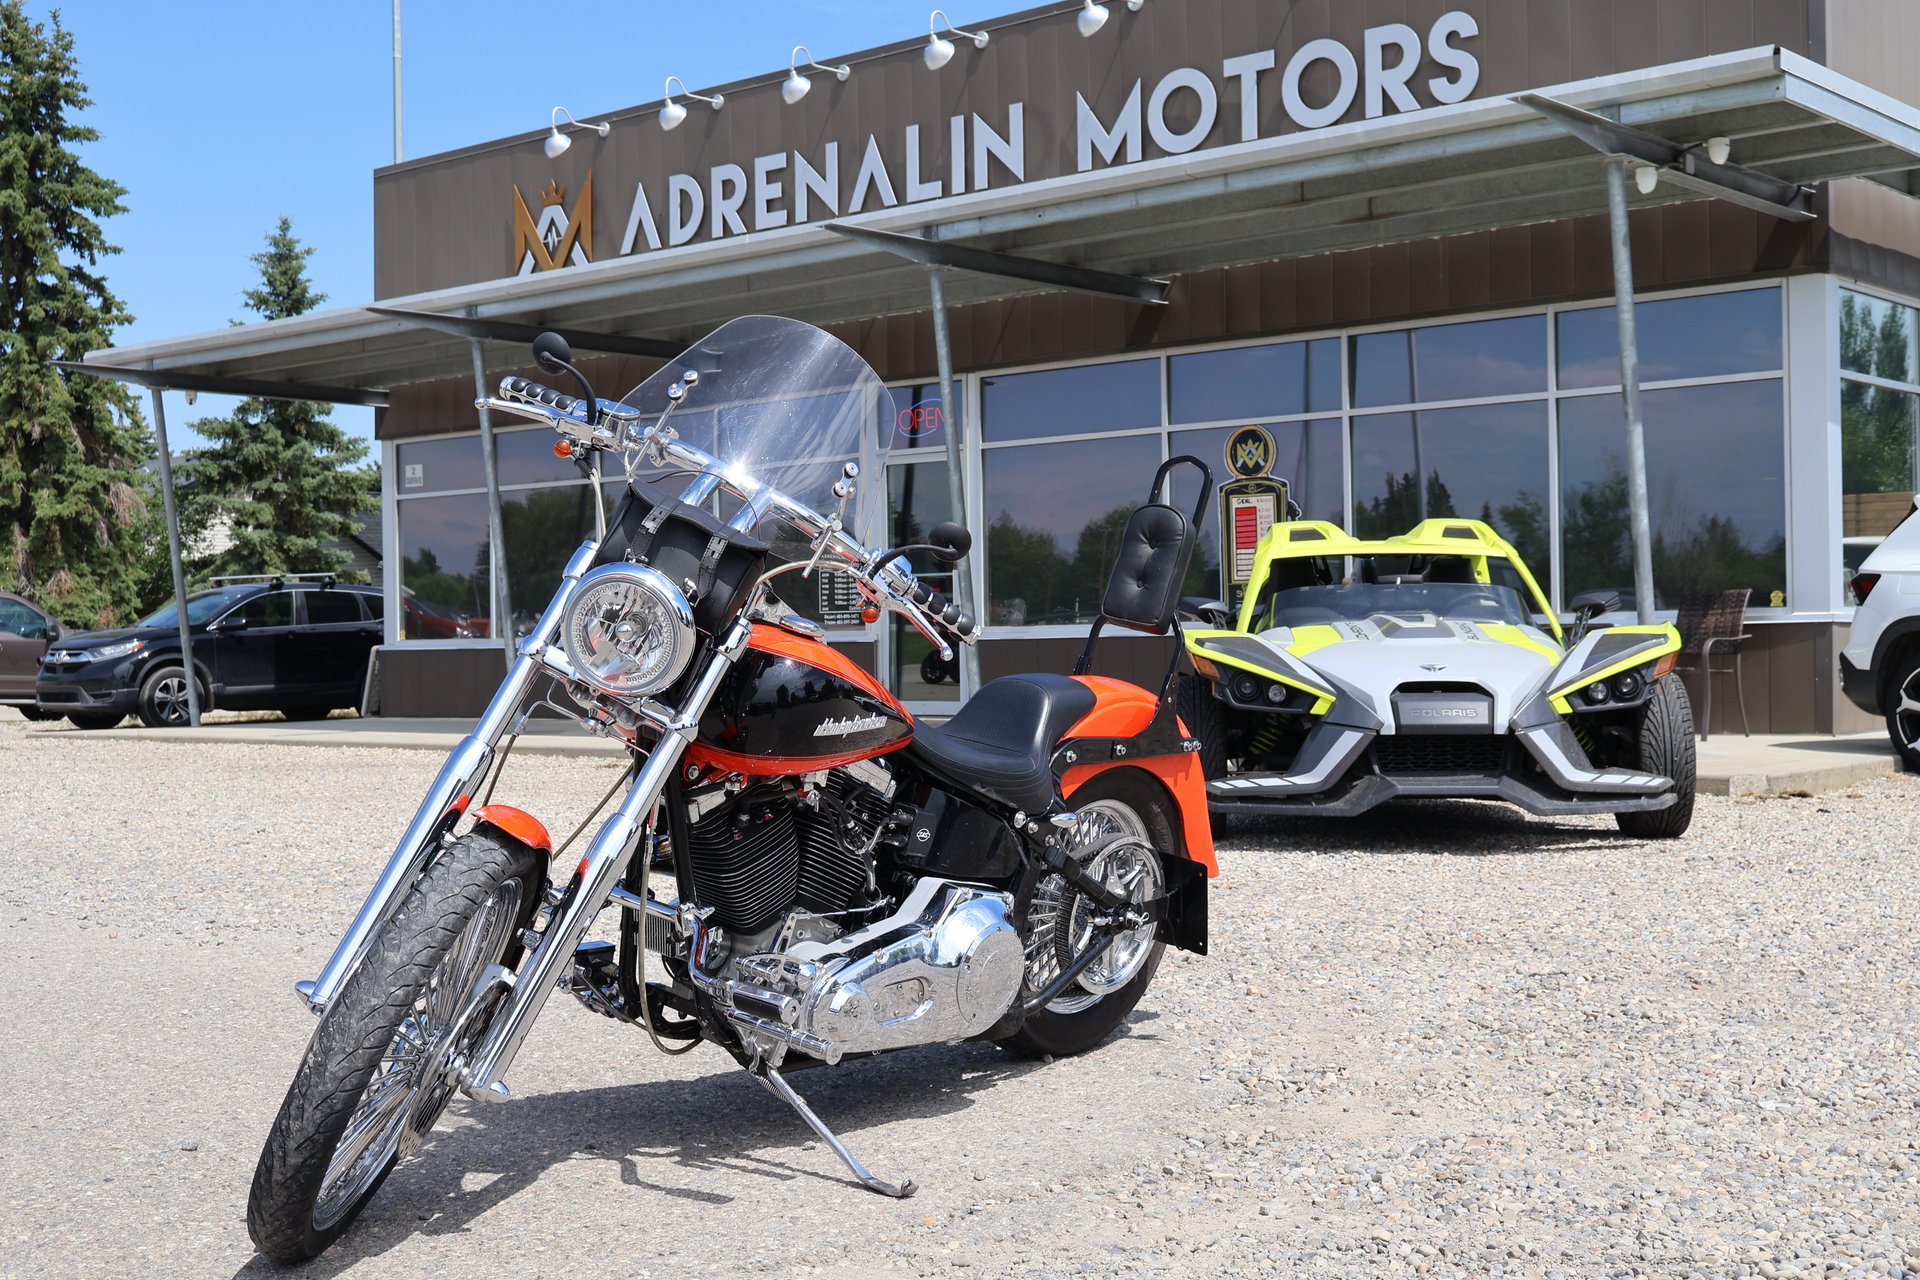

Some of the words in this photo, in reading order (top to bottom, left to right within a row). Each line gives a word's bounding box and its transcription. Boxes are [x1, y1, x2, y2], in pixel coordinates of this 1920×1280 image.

[619, 102, 1024, 255] ADRENALIN
[1076, 10, 1480, 171] MOTORS
[898, 407, 945, 431] OPEN
[1410, 708, 1477, 717] POLARIS
